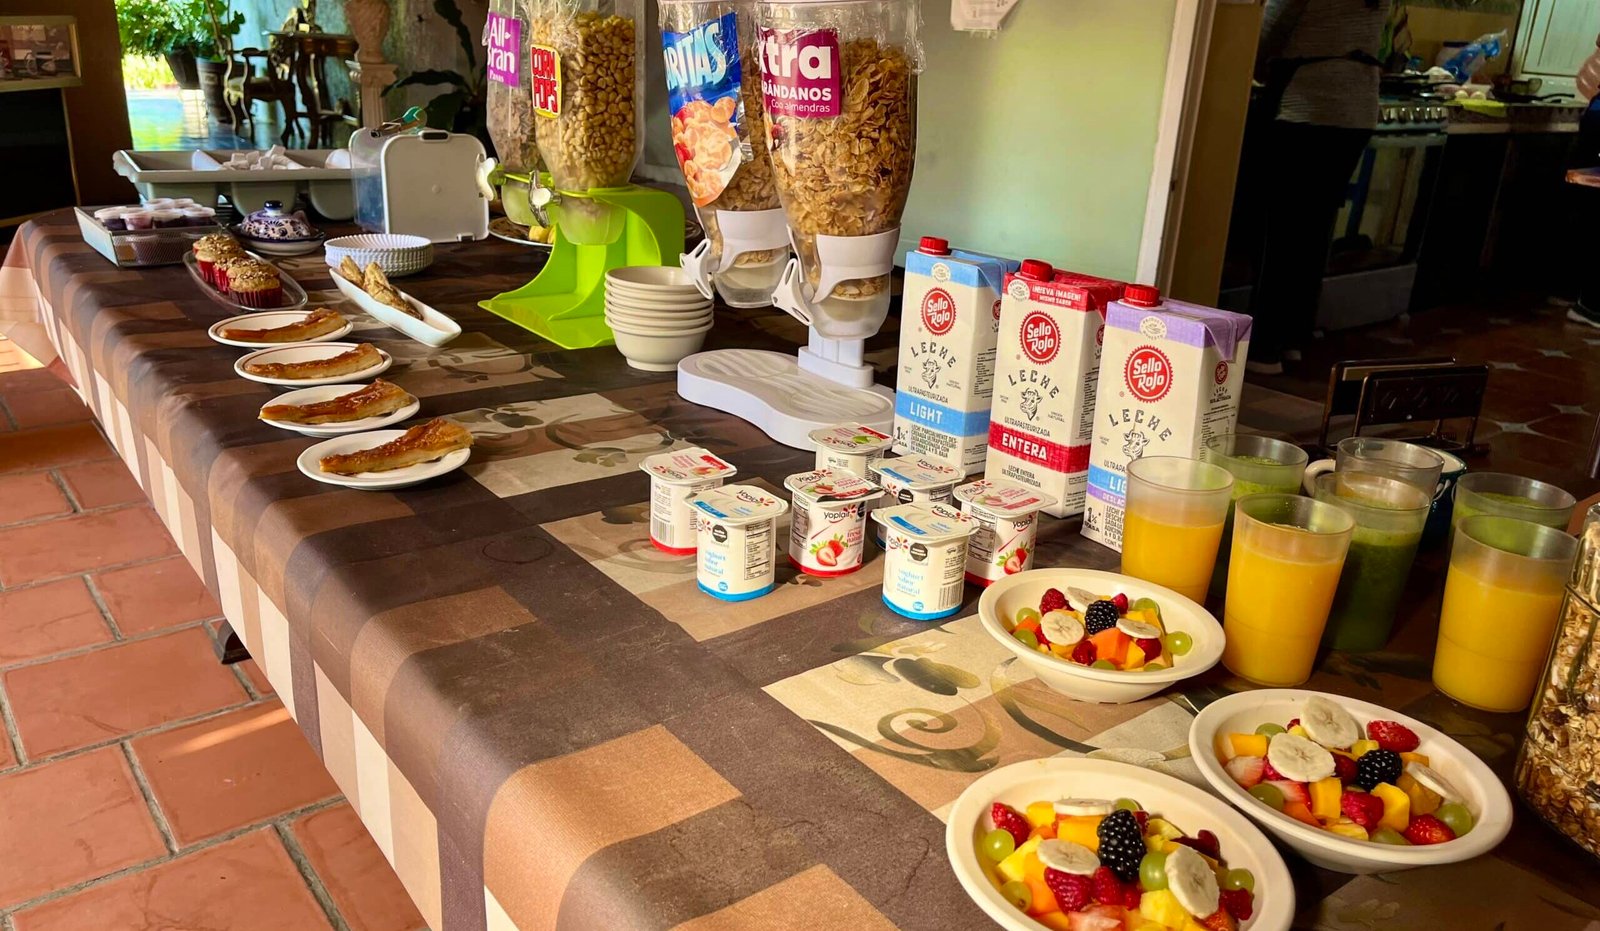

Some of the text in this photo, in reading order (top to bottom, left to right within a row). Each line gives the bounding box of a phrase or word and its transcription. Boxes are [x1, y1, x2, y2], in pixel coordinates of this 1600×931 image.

[489, 17, 511, 47] All-
[532, 47, 556, 80] CORN
[534, 77, 558, 113] POPS
[762, 79, 832, 102] RÁNDANOS
[784, 101, 831, 113] almendras
[927, 298, 948, 313] Sello
[928, 311, 950, 328] Rojo
[1027, 322, 1051, 339] Sello
[911, 342, 957, 368] LECHE
[1027, 336, 1054, 355] Rojo
[1133, 357, 1163, 375] Sello
[1008, 370, 1060, 399] LECHE
[1133, 373, 1165, 393] Rojo
[910, 401, 943, 424] LIGHT
[1004, 416, 1051, 437] ULTRAPASTEURIZADA
[1108, 408, 1173, 442] LECHE
[1002, 432, 1048, 460] ENTERA
[823, 509, 850, 521] yoplait
